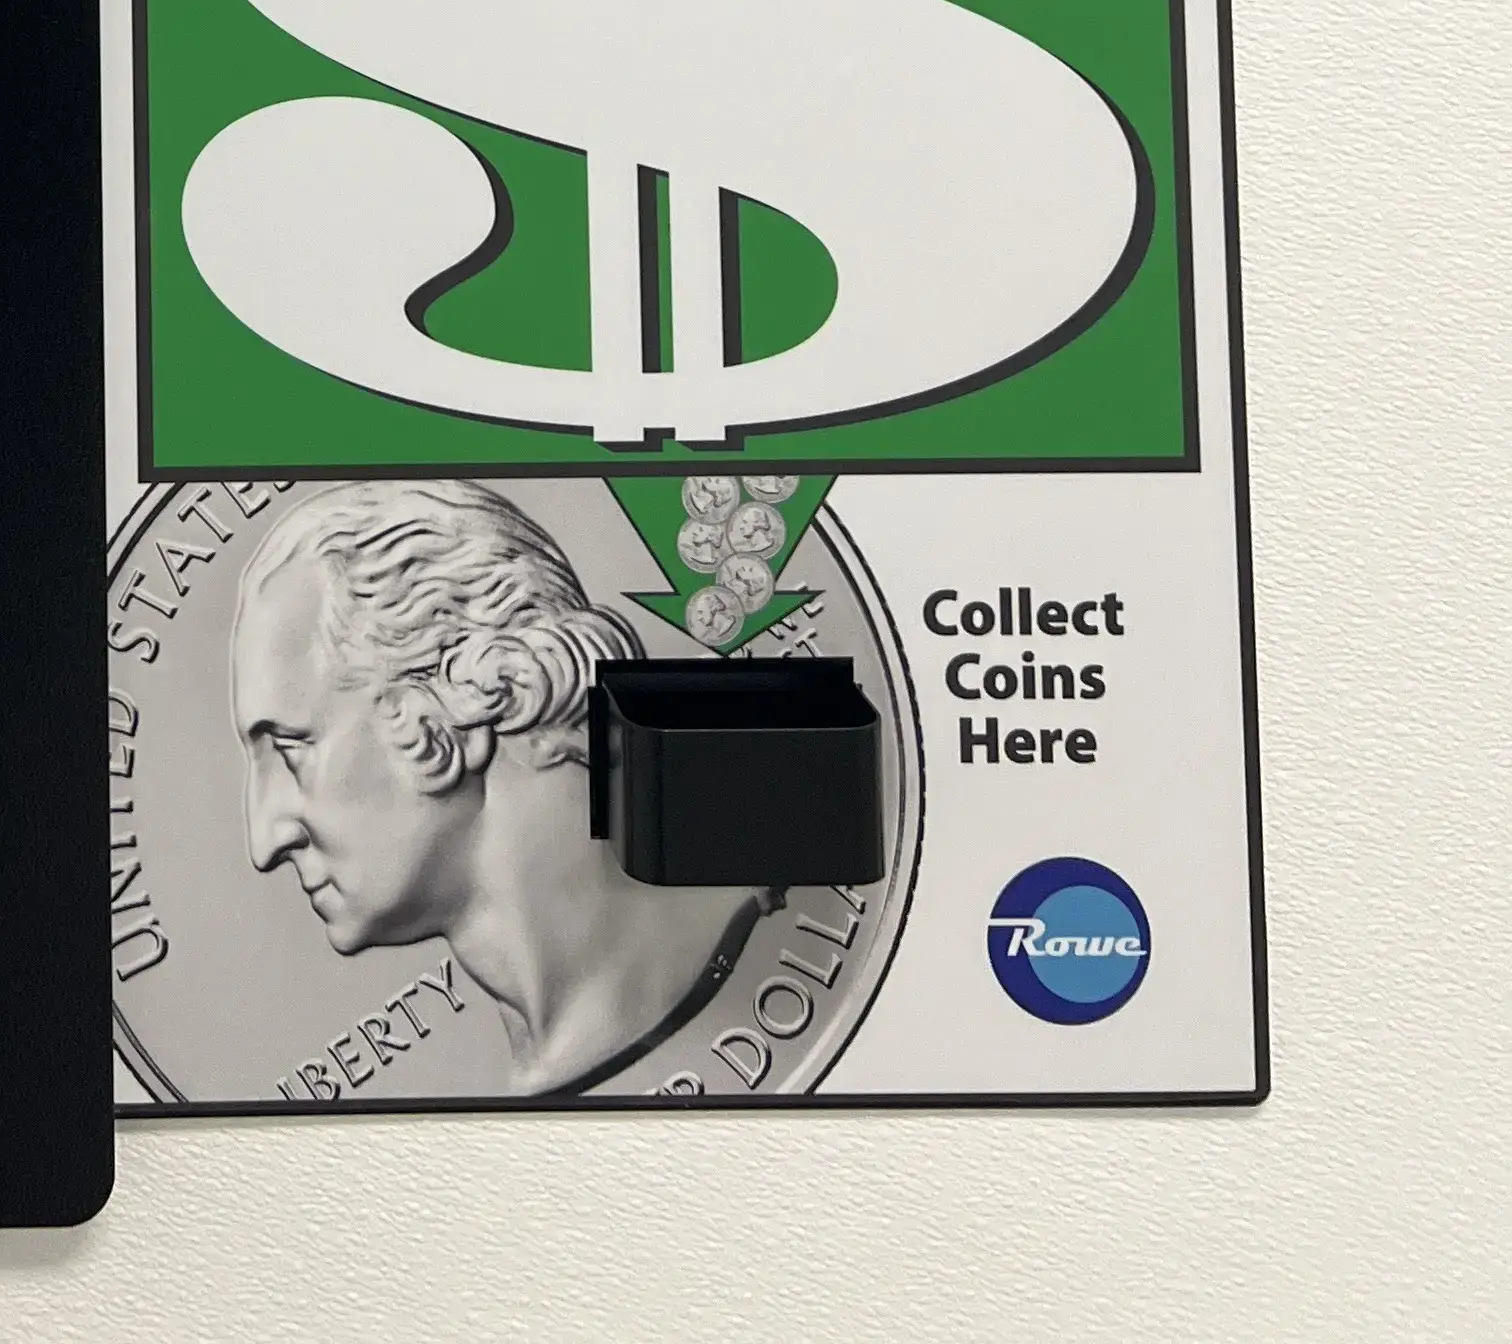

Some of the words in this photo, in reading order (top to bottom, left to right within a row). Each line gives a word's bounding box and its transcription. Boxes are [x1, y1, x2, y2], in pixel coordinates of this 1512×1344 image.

[107, 481, 296, 664] STATE
[923, 587, 1125, 637] Collect
[945, 650, 1106, 700] Coins
[959, 716, 1097, 764] Here
[987, 918, 1148, 957] Rowe
